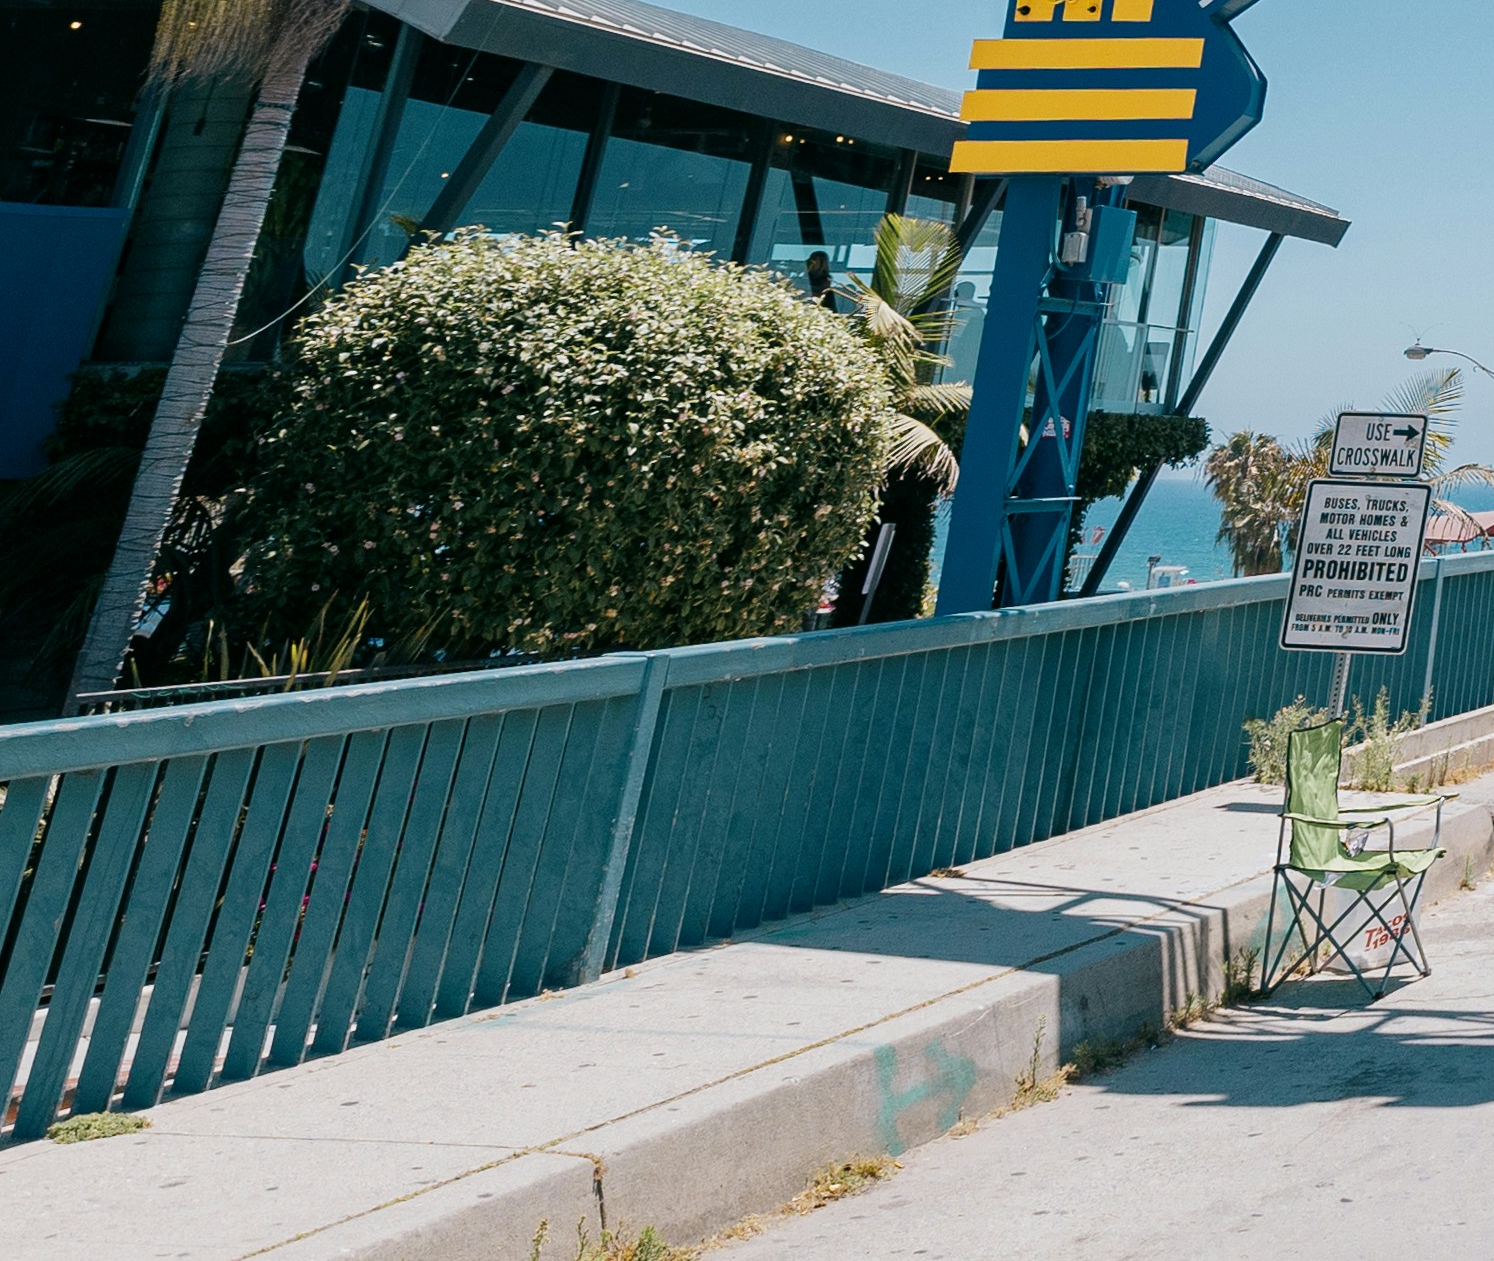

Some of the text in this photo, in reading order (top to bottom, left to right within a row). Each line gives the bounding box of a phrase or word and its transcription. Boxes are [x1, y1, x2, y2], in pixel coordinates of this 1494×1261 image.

[1366, 423, 1393, 441] USE
[1336, 447, 1416, 468] CROSSWALK
[1324, 497, 1409, 513] BUSES, TRUCKS,
[1319, 513, 1408, 528] MOTOR HOMES &
[1325, 528, 1398, 542] ALL VEHICLES
[1307, 542, 1411, 559] OVER 22 FEET LONG
[1302, 559, 1408, 582] PROHIBITED
[1299, 585, 1404, 601] PRC PERMITS EXEMPT
[1295, 612, 1400, 626] DELIVERIES PERMITTED ONLY
[1291, 624, 1309, 632] FROM
[1311, 624, 1316, 632] 5
[1335, 625, 1343, 633] TO
[1371, 626, 1400, 635] MON-FRI
